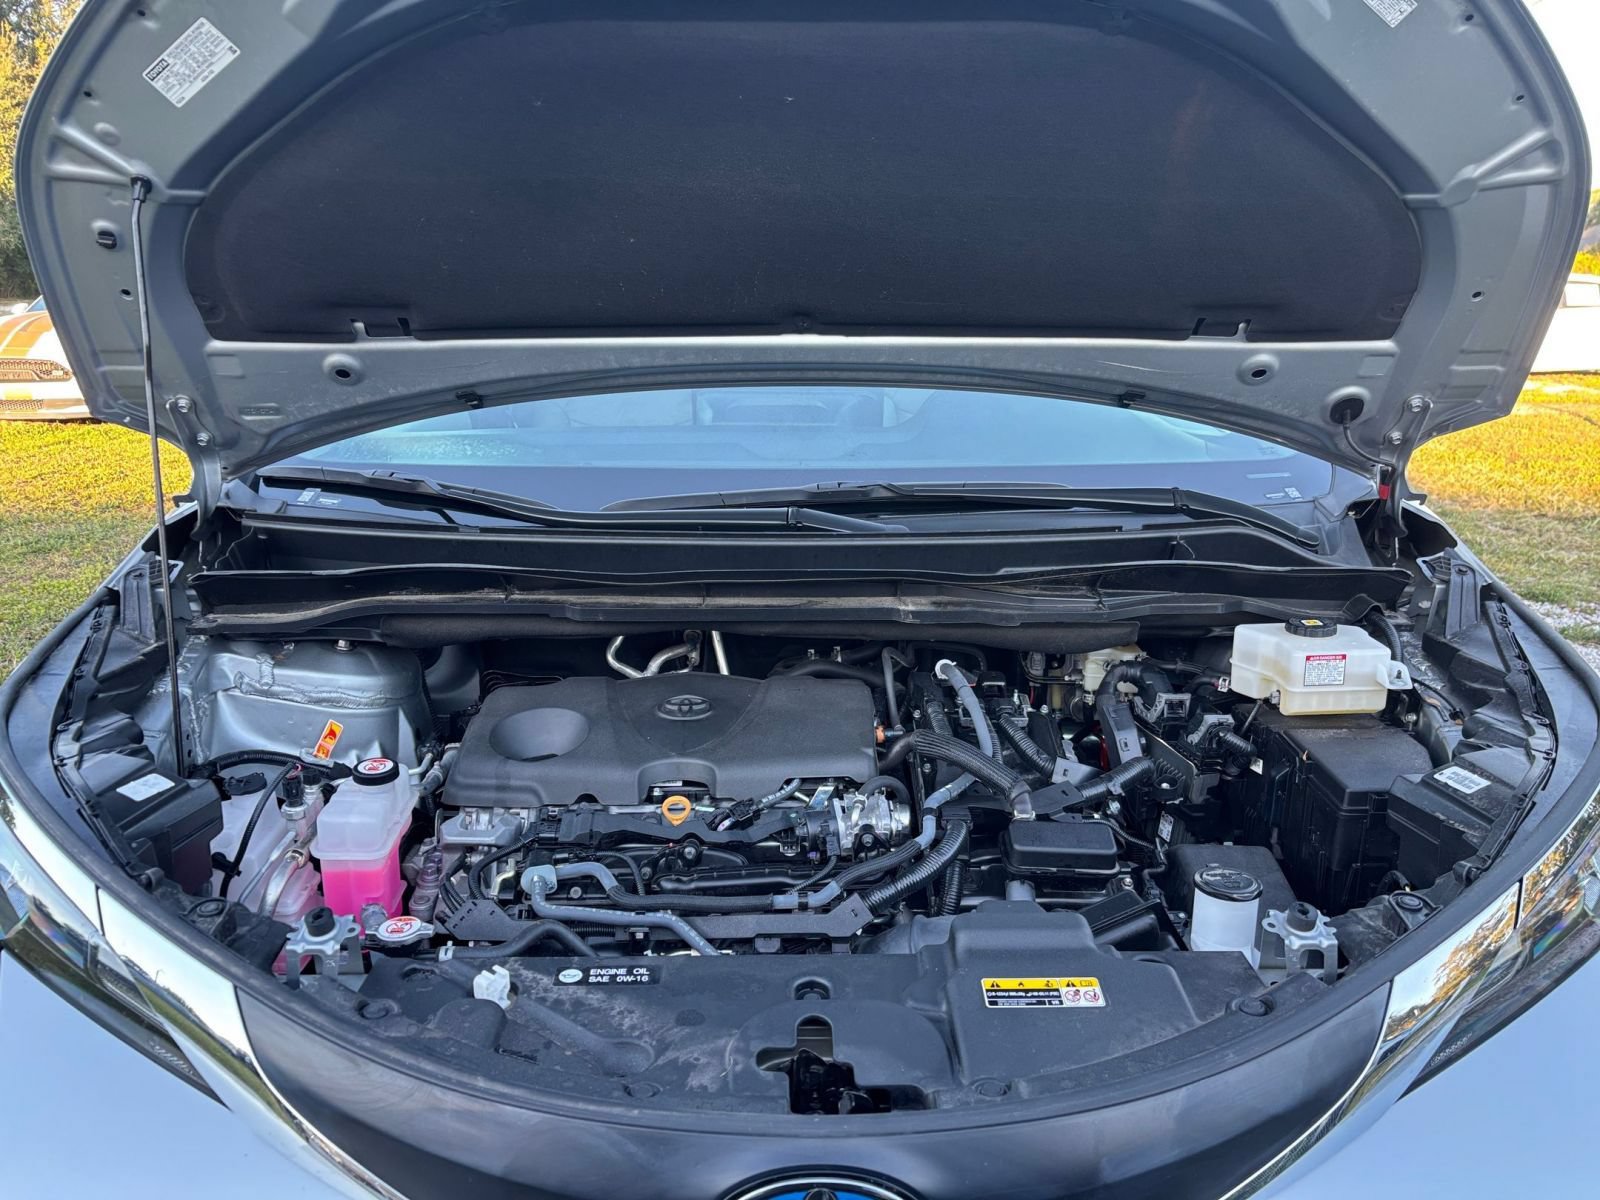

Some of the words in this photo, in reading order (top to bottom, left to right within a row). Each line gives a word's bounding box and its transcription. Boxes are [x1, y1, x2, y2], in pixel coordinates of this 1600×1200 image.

[147, 60, 168, 80] TOYOTA
[633, 967, 650, 975] OIL
[588, 975, 610, 983] SAE
[616, 975, 649, 983] 0W-16
